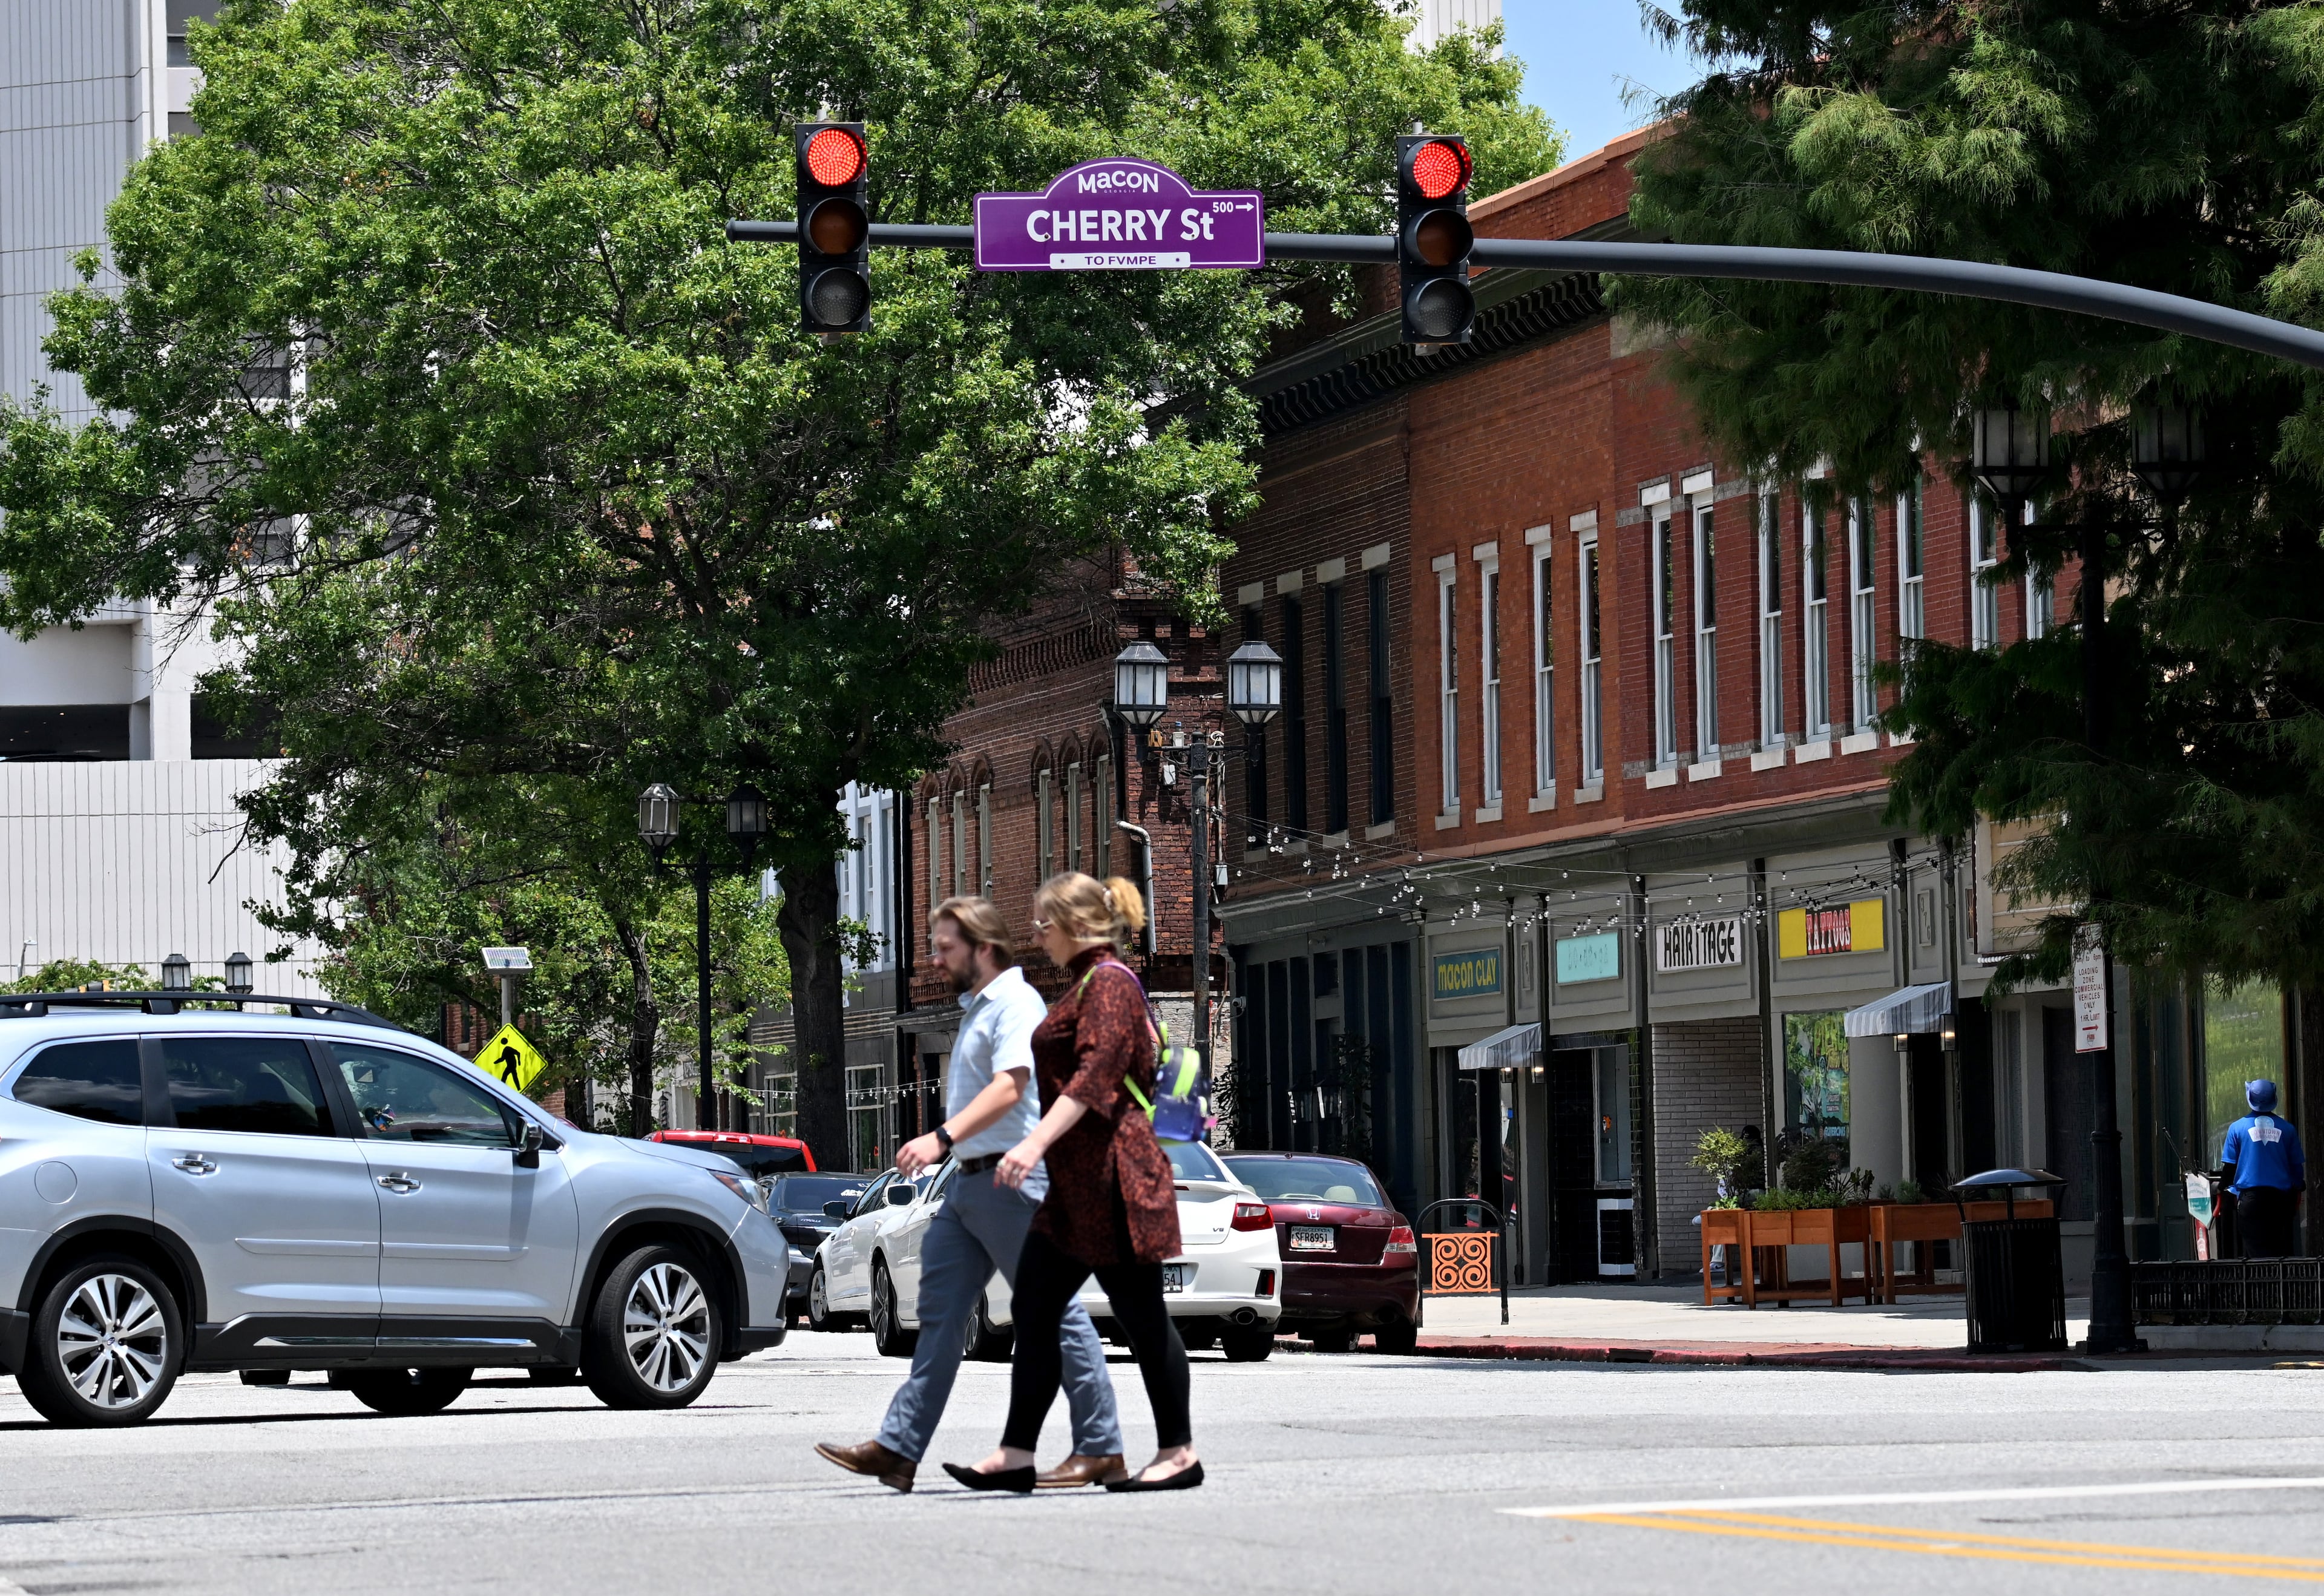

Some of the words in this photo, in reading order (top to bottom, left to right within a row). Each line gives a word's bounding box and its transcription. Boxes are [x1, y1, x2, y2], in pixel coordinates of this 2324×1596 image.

[1026, 209, 1171, 242] CHERRY
[1180, 208, 1214, 241] St
[1212, 202, 1234, 213] 500
[1085, 256, 1105, 265] TO
[1108, 256, 1157, 265] FVMPE
[1806, 908, 1851, 954] TATTOOS
[1475, 957, 1496, 987] CLAY
[2078, 967, 2098, 976] LOADING
[2075, 983, 2104, 993] COMMERCIAL
[2078, 992, 2100, 1002] VEHICLES
[2090, 1013, 2100, 1022] LIMIT
[1295, 1232, 1328, 1243] SFR8951
